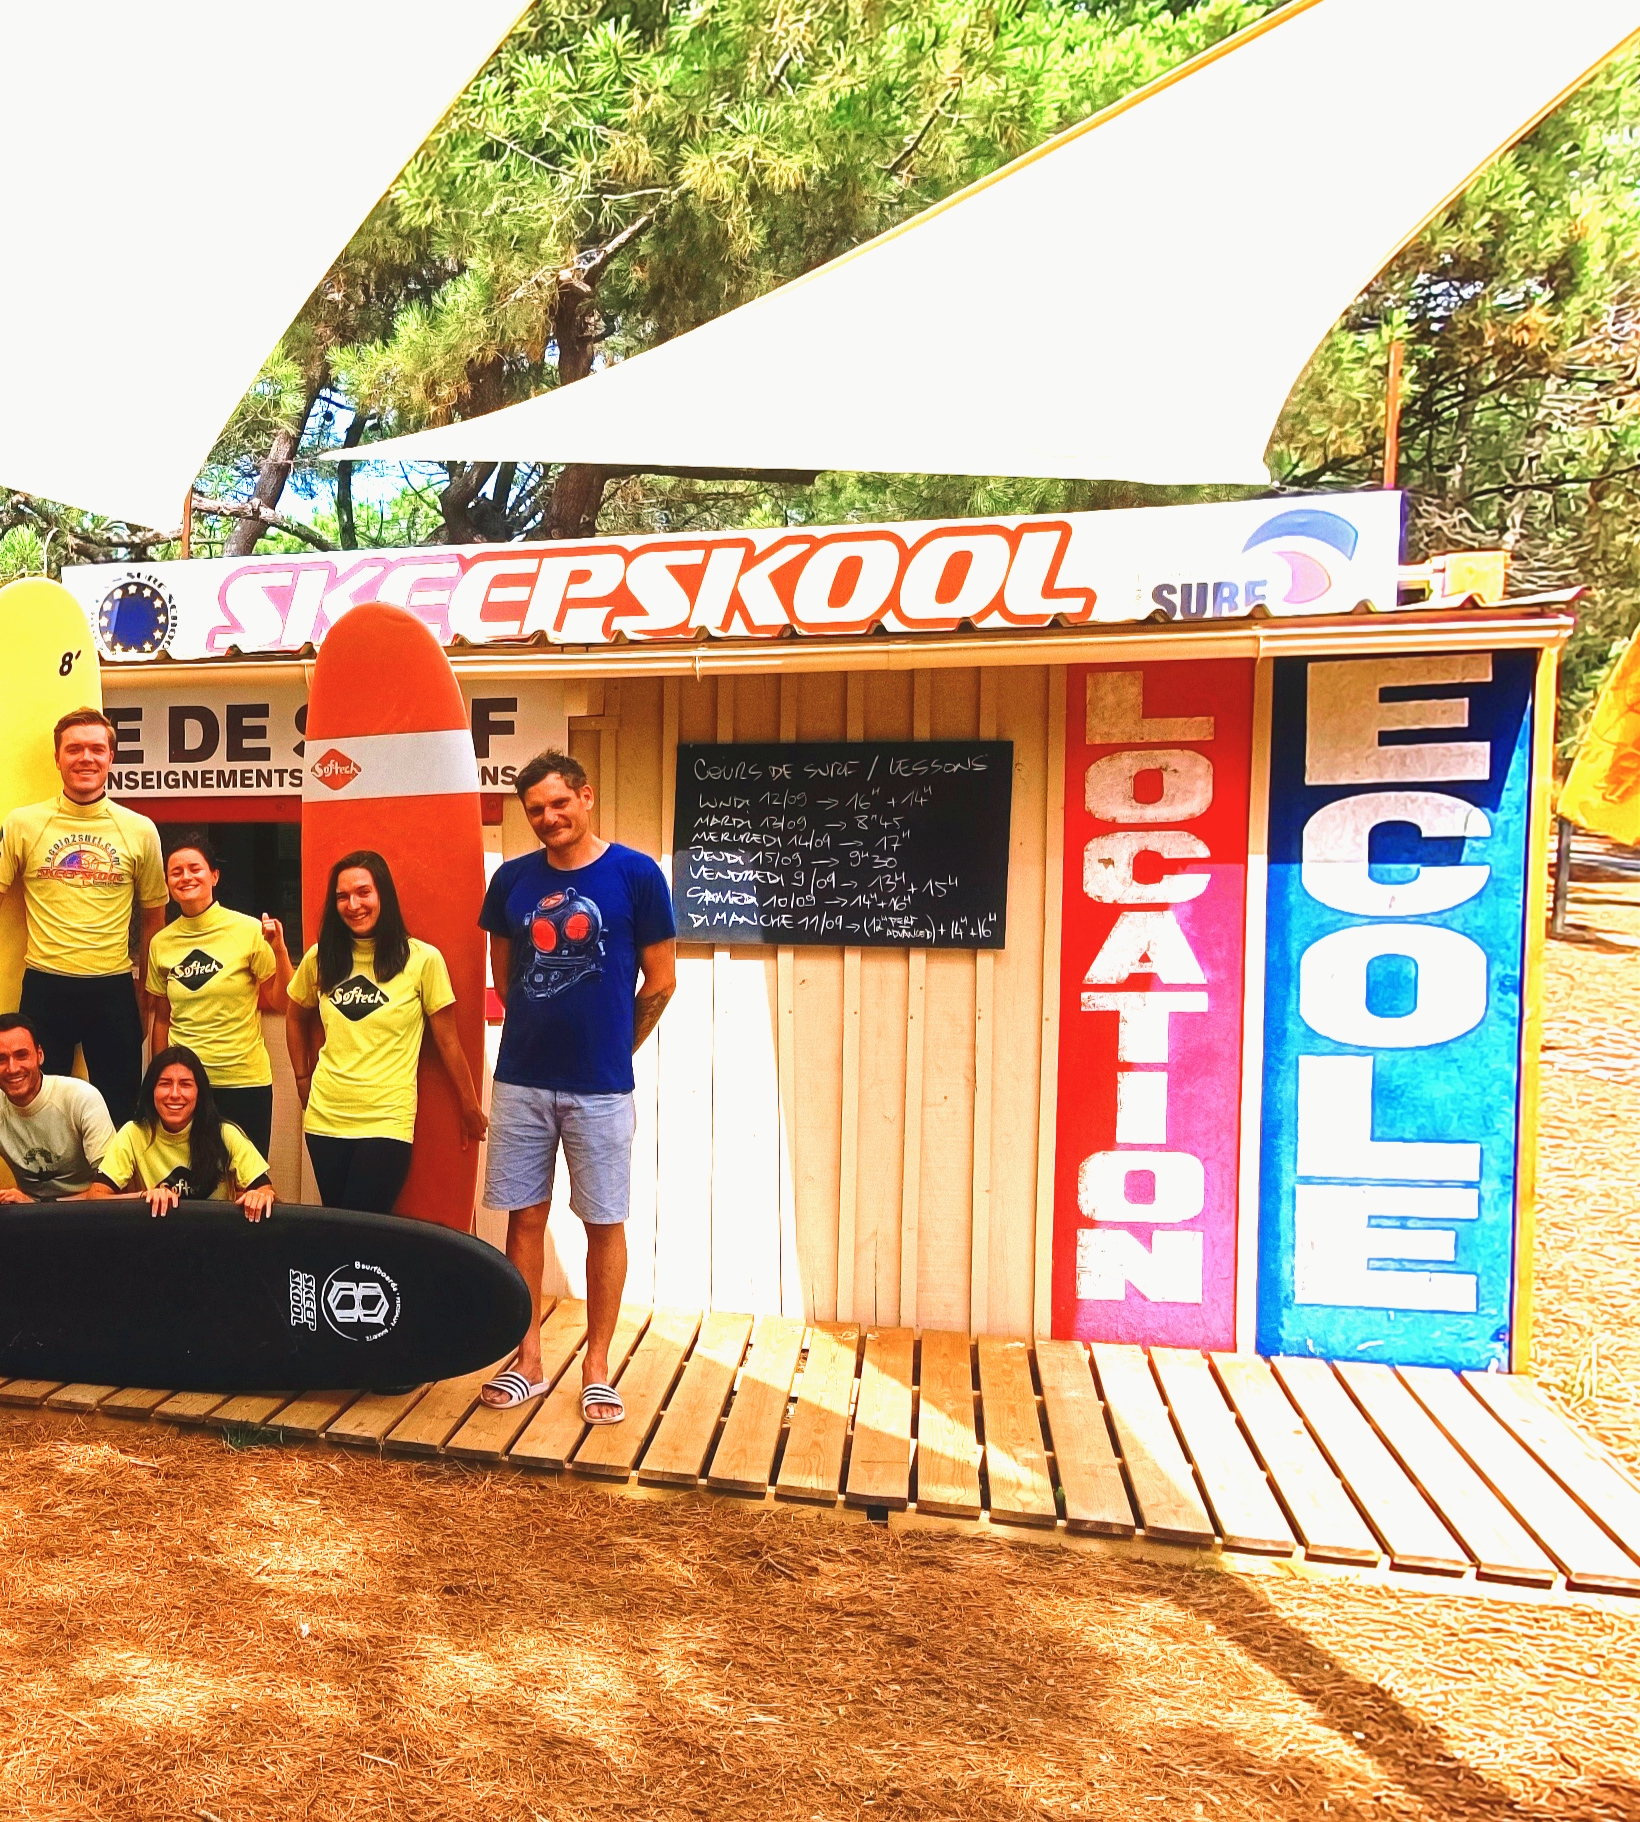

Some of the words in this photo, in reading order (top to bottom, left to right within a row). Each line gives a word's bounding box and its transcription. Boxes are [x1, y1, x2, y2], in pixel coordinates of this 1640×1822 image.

[207, 521, 1097, 652] SKEEPSKOOL
[1151, 579, 1268, 620] SURF
[58, 650, 82, 677] 8'
[168, 703, 271, 764] DE
[106, 768, 303, 790] NSEIGNEMENTS
[310, 759, 362, 778] Softech
[694, 758, 763, 781] COURS
[768, 764, 794, 781] DE
[803, 761, 860, 779] SURF
[889, 754, 989, 777] LESSONS
[758, 788, 808, 811] 12/09
[760, 814, 807, 832] 13/09
[787, 829, 831, 850] 14/09
[749, 850, 802, 869] 15/09
[762, 892, 816, 909] 10/09
[797, 910, 844, 936] 11/09
[168, 960, 224, 978] Softech
[329, 985, 390, 1005] Softech
[1076, 670, 1215, 1304] LOCATION
[1294, 653, 1493, 1313] ECOLE
[289, 1268, 304, 1327] SKOOL
[302, 1273, 317, 1332] SKEEP
